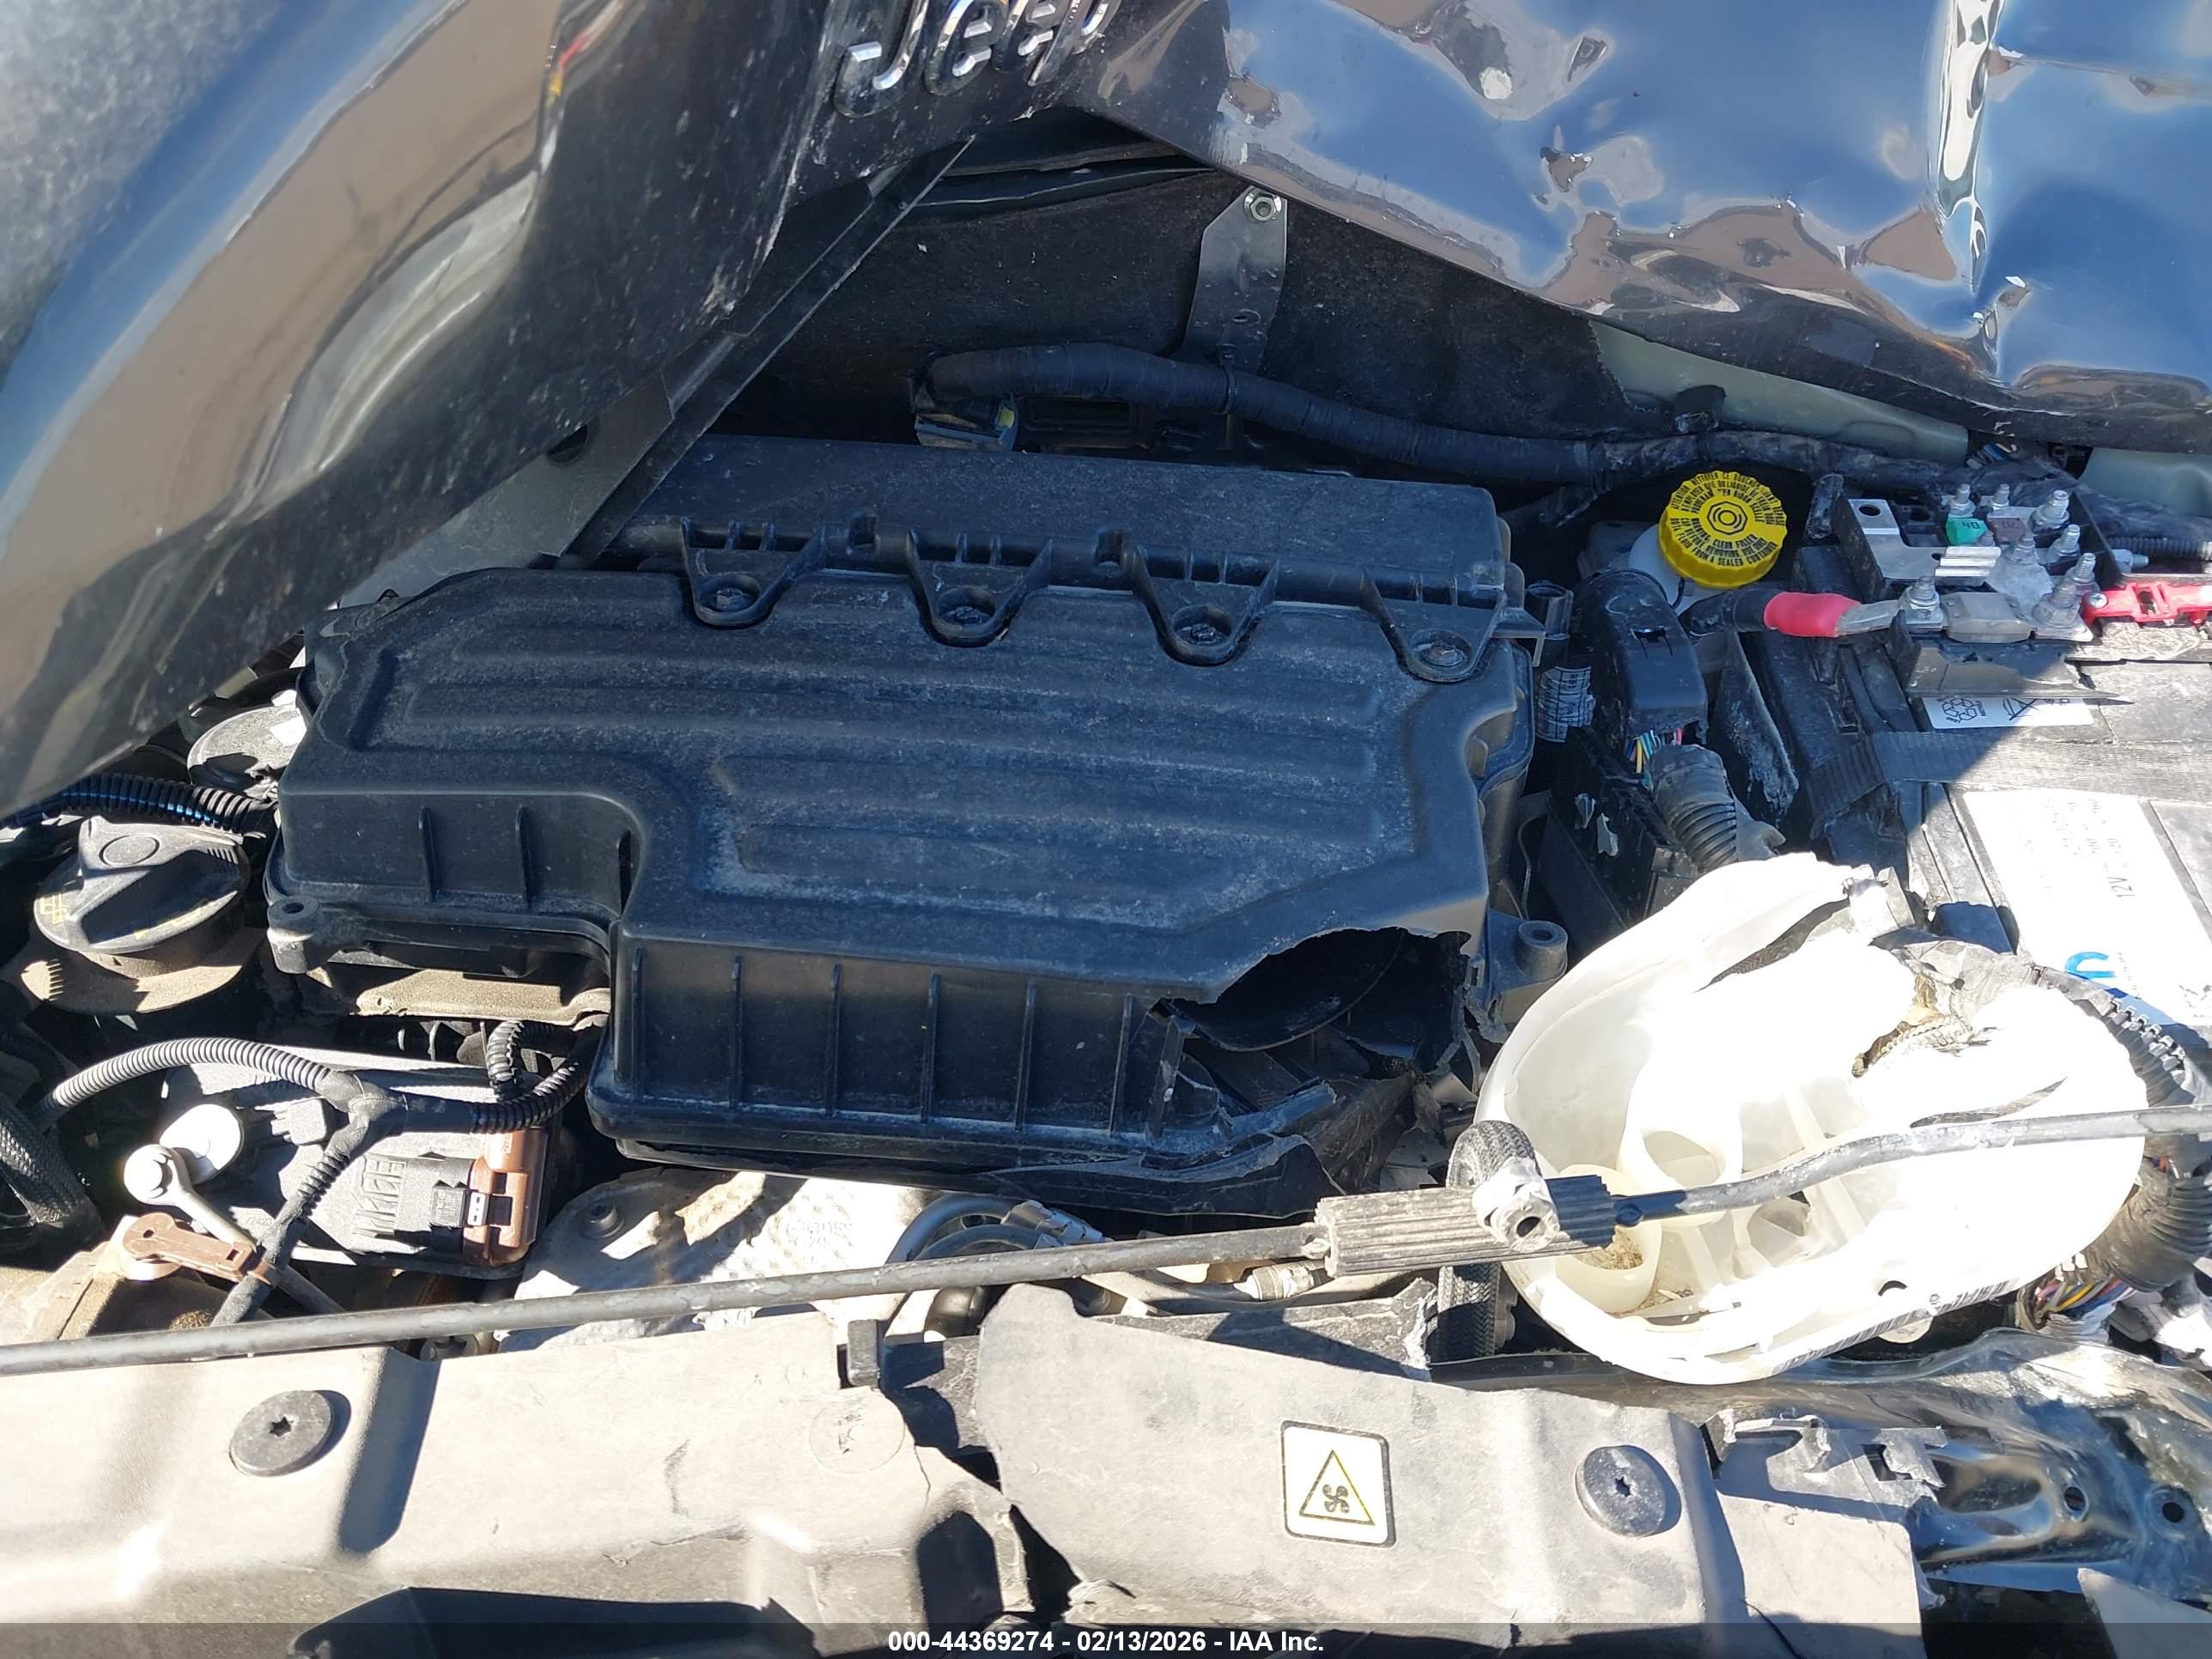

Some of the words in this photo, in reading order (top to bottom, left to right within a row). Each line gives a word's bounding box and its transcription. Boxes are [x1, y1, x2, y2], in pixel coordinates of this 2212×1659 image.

[1961, 521, 1980, 530] 40
[1692, 548, 1708, 560] FROM
[2104, 876, 2136, 898] 12V
